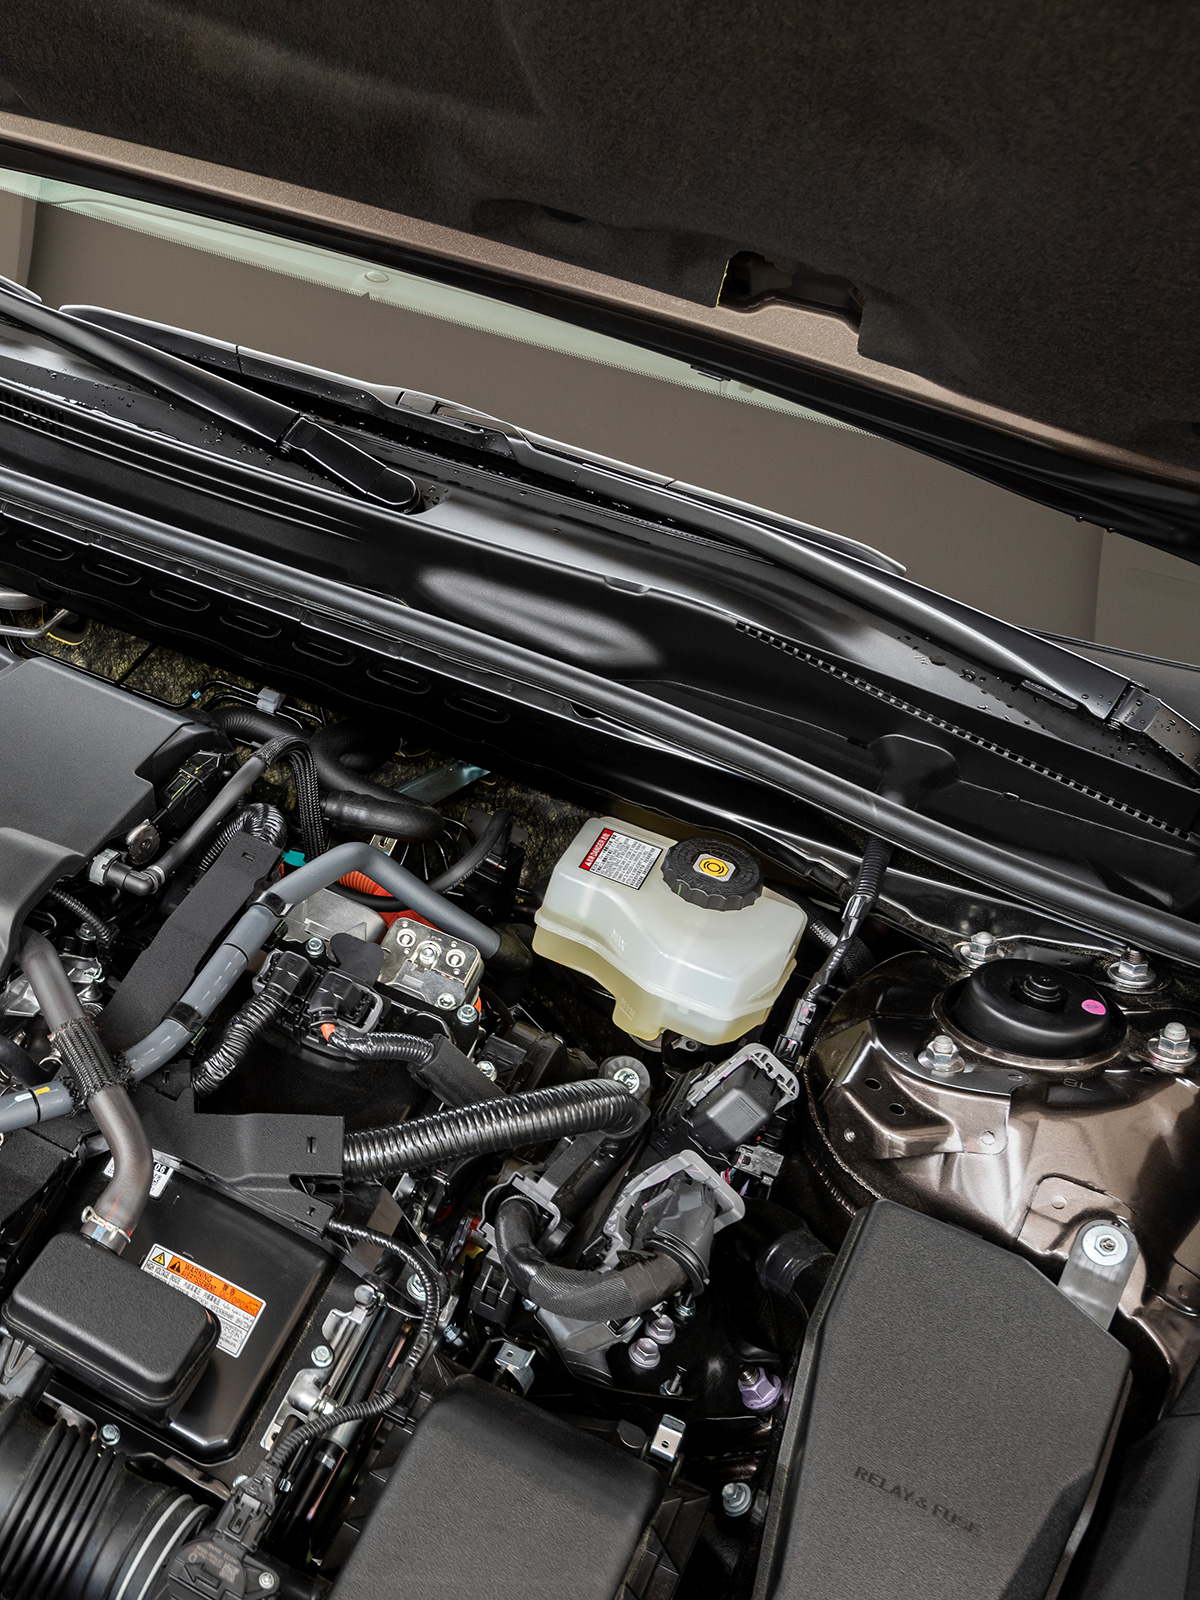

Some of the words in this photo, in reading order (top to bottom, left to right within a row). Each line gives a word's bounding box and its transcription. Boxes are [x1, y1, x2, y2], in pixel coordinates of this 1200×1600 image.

[181, 1270, 217, 1293] AVERTISSEMENT
[184, 1264, 214, 1283] WARNING
[854, 1466, 914, 1502] RELAY
